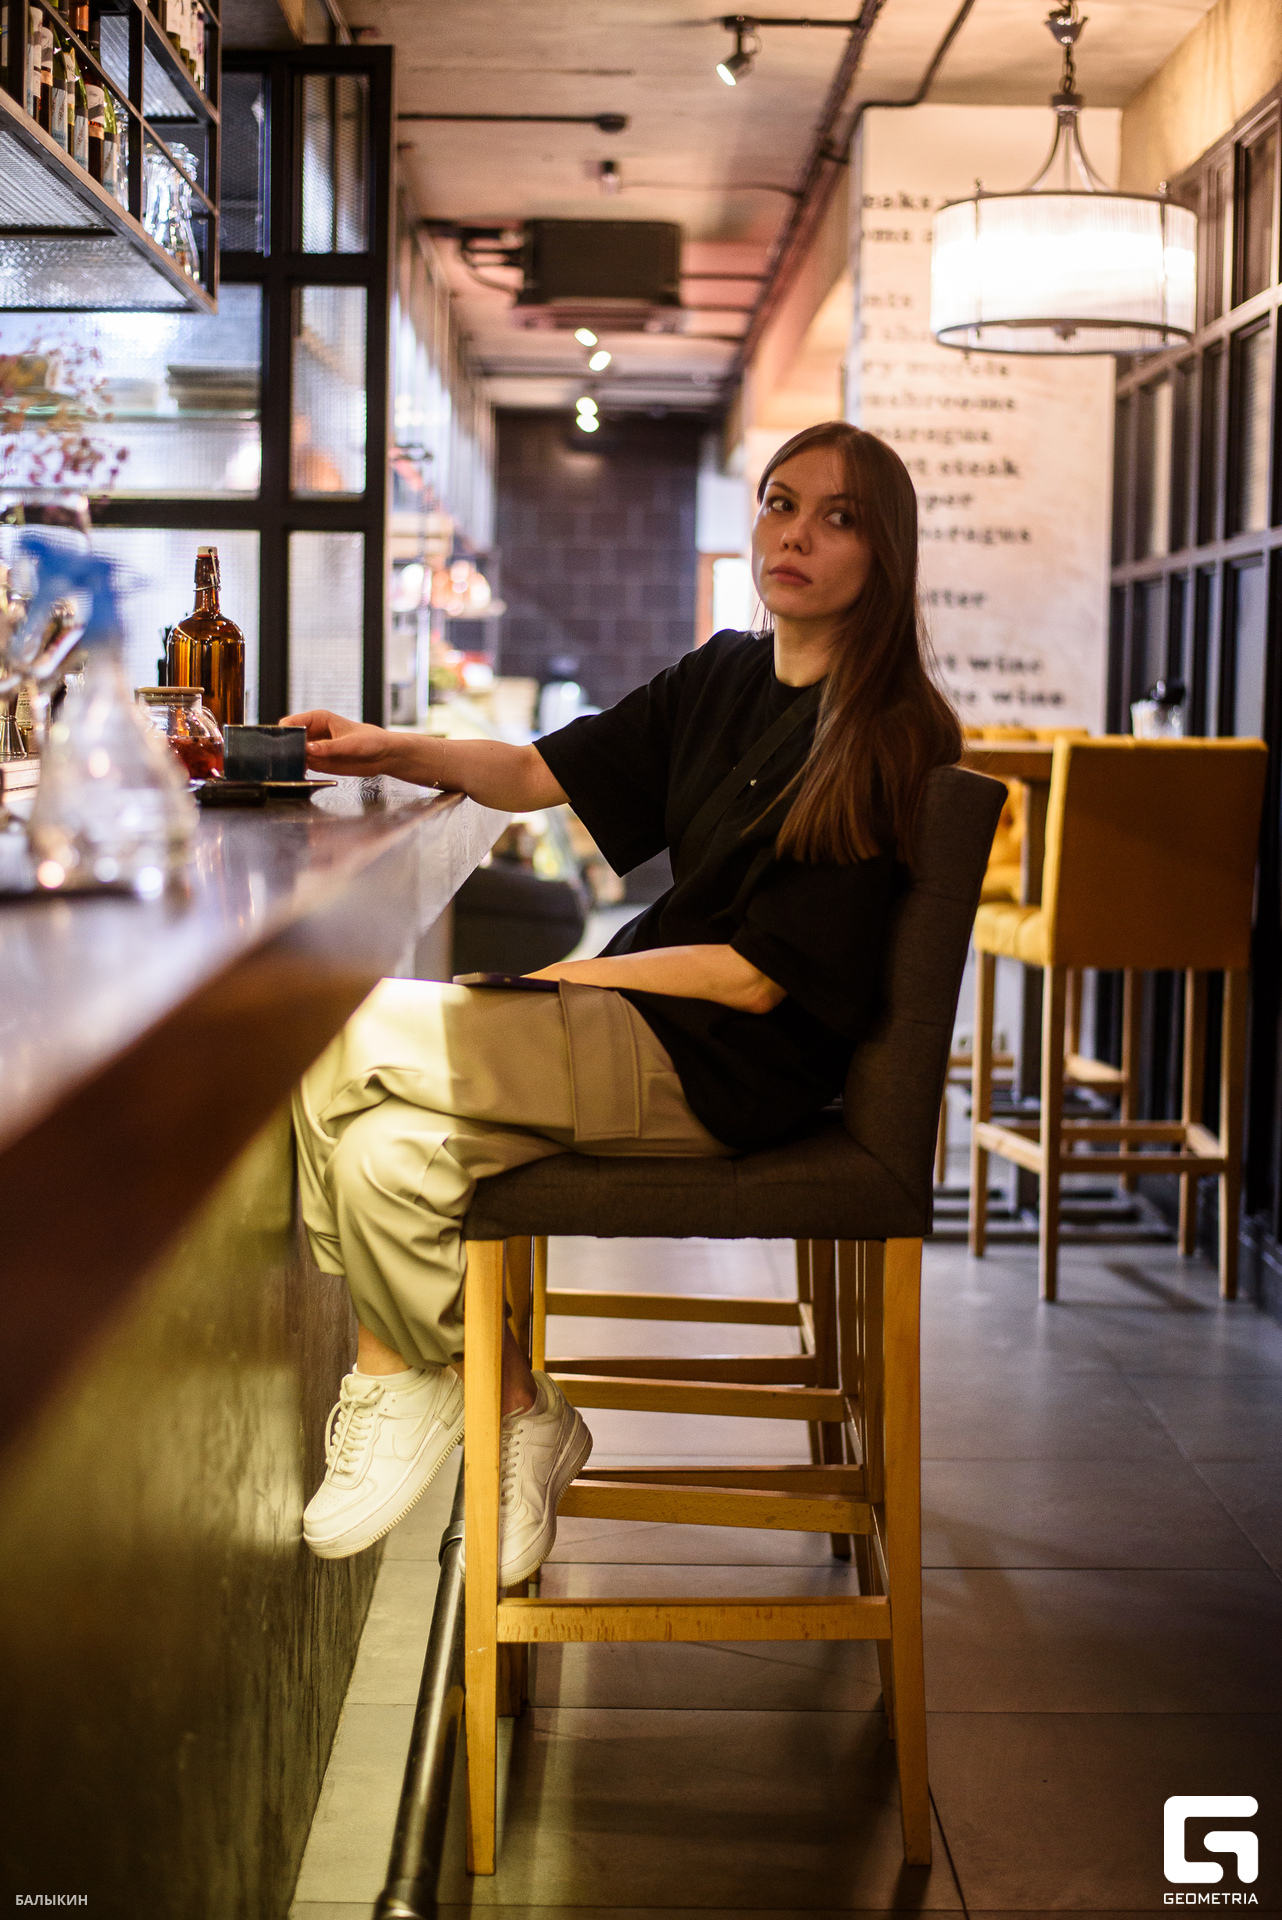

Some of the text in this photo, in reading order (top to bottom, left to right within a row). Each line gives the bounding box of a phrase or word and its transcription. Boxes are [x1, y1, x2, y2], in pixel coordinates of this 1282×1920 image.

[939, 458, 1019, 476] steak
[969, 655, 1041, 674] wine
[992, 688, 1064, 707] wine
